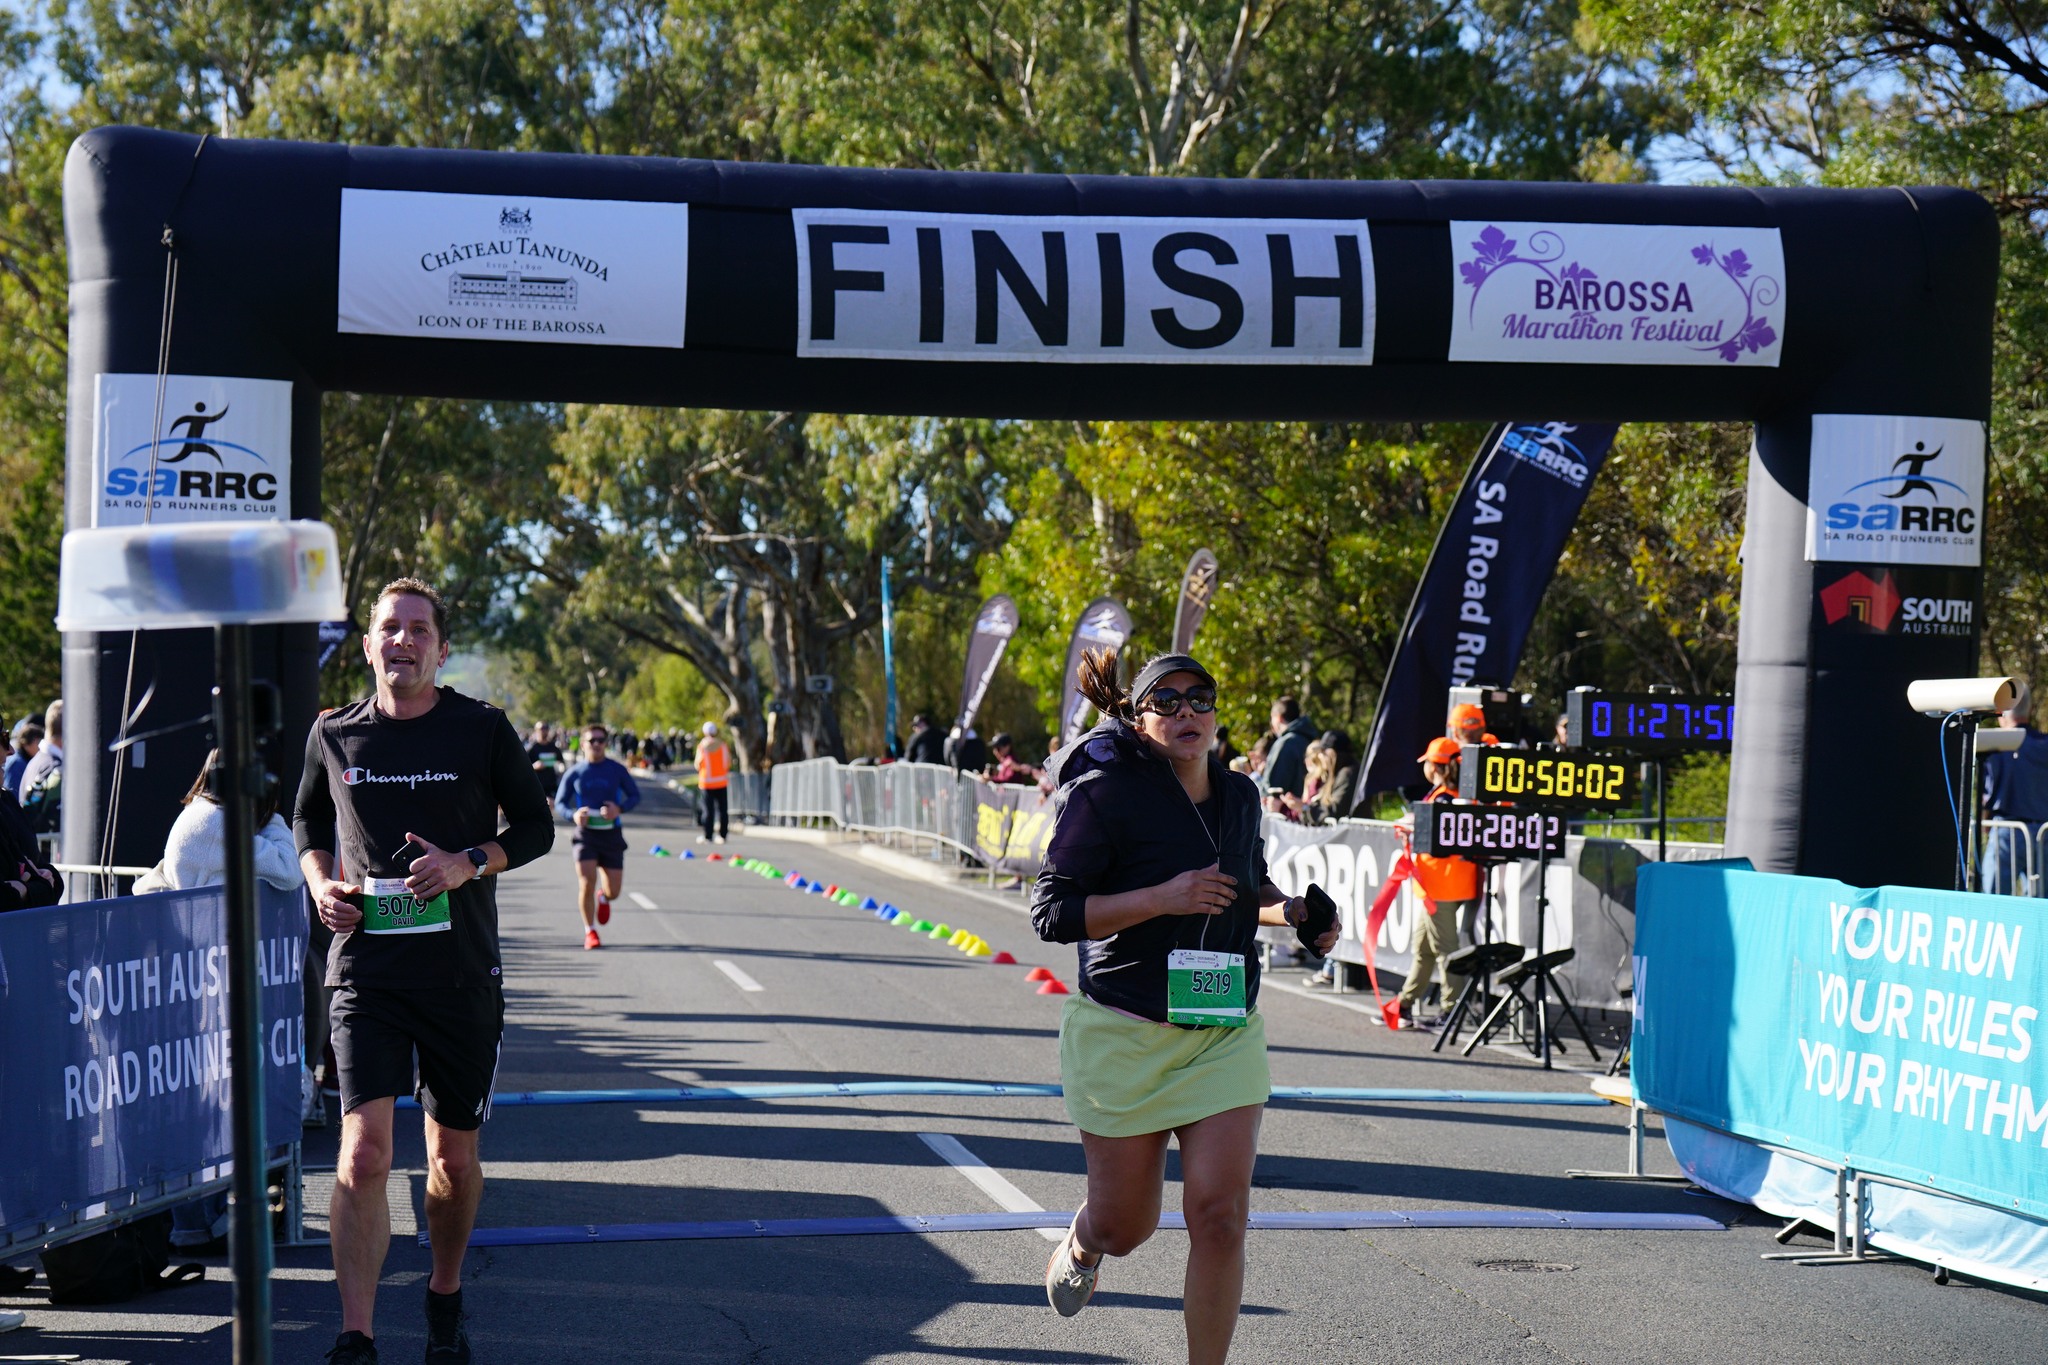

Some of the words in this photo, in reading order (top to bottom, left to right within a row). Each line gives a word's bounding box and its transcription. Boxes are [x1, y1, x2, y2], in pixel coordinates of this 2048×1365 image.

[420, 240, 513, 273] CHÂTEAU
[516, 237, 608, 281] TANUNDA
[808, 224, 1363, 350] FINISH
[1535, 279, 1693, 312] BAROSSA
[448, 300, 501, 308] BAROSSA
[510, 302, 577, 311] AUSTRALIA
[418, 315, 461, 327] ICON
[466, 317, 488, 329] OF
[494, 318, 527, 331] THE
[532, 320, 606, 334] BAROSSA
[1502, 313, 1622, 341] Marathon
[1631, 316, 1724, 342] Festival
[125, 501, 161, 509] ROAD
[169, 502, 237, 512] RUNNERS
[244, 504, 276, 513] CLUB
[1473, 480, 1507, 525] SA
[1847, 533, 1884, 541] ROAD
[1891, 535, 1948, 544] RUNNERS
[1953, 537, 1975, 545] CLUB
[1460, 535, 1499, 625] Road
[1902, 597, 1973, 623] SOUTH
[1902, 623, 1971, 635] AUSTRALIA
[343, 767, 458, 789] Champion
[1485, 756, 1625, 800] 00:58:02
[1439, 812, 1559, 850] 00:28:02
[377, 895, 428, 916] 5079
[392, 916, 415, 926] DAVID
[1829, 902, 1932, 968] YOUR
[1941, 915, 2022, 981] RUN
[67, 956, 161, 1024] SOUTH
[169, 936, 301, 1004] AUSTALIA
[1191, 969, 1231, 995] 5219
[1817, 970, 1913, 1039] YOUR
[1921, 988, 2038, 1063] RULES
[64, 1050, 141, 1121] ROAD
[148, 1023, 264, 1097] RUNNE
[1797, 1038, 1885, 1109] YOUR
[1893, 1058, 2048, 1149] RHYTHM
